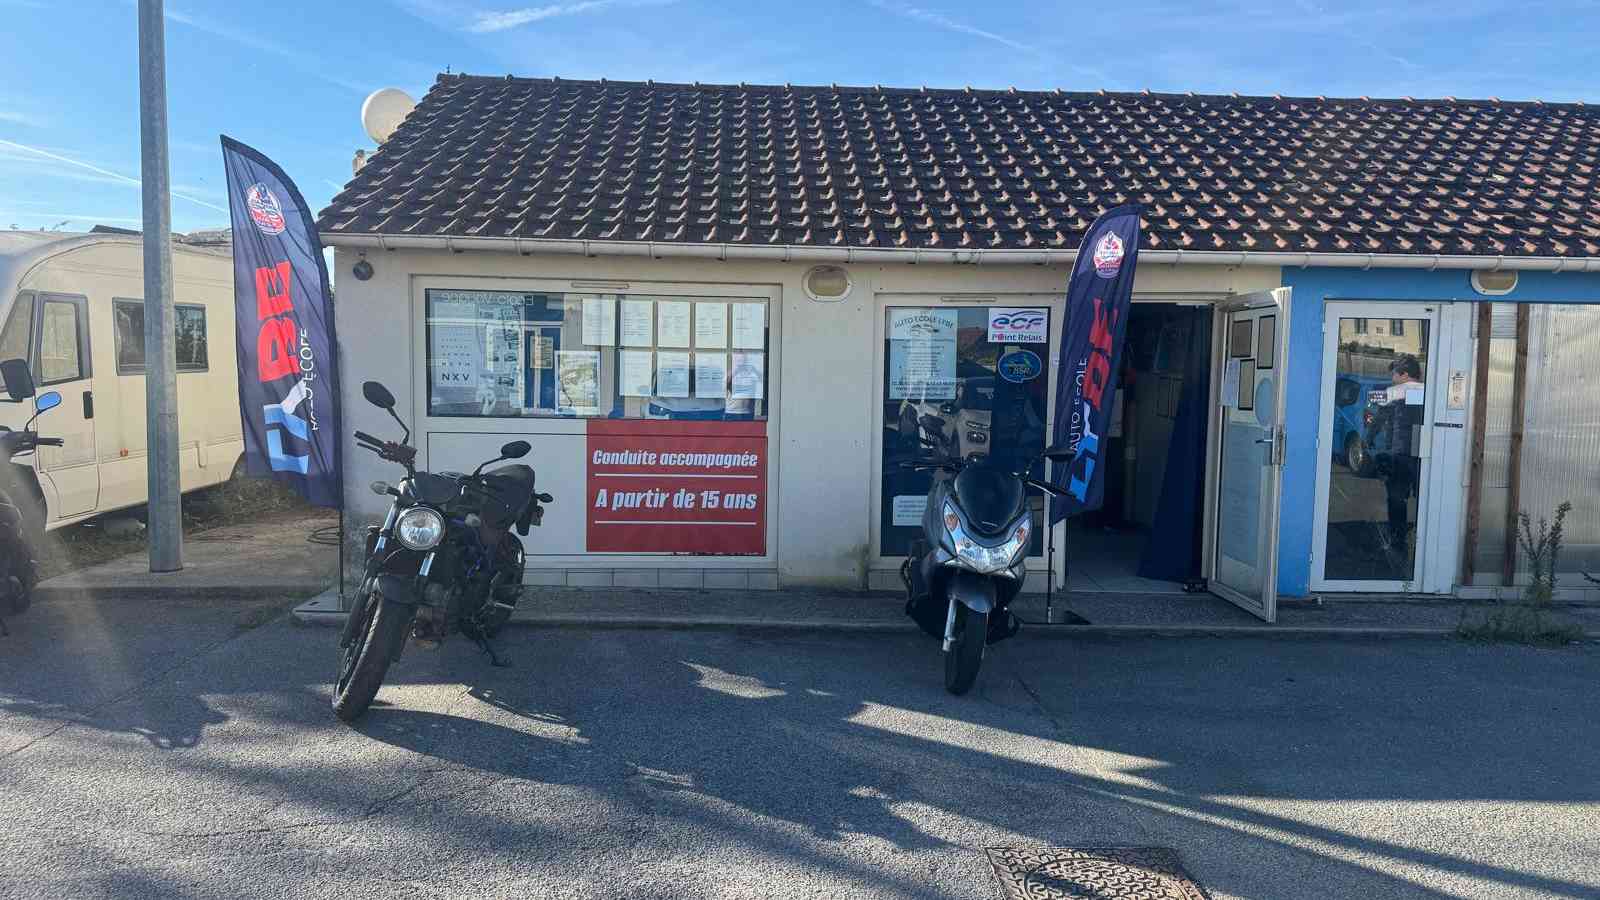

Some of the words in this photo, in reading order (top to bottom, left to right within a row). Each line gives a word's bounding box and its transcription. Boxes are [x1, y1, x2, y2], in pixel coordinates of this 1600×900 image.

[1017, 332, 1043, 342] Relais
[592, 449, 657, 465] Conduite
[659, 451, 758, 468] accompagnée
[595, 488, 608, 508] A
[611, 487, 670, 511] partir
[672, 488, 696, 509] de
[700, 490, 720, 509] 15
[723, 493, 758, 510] ans
